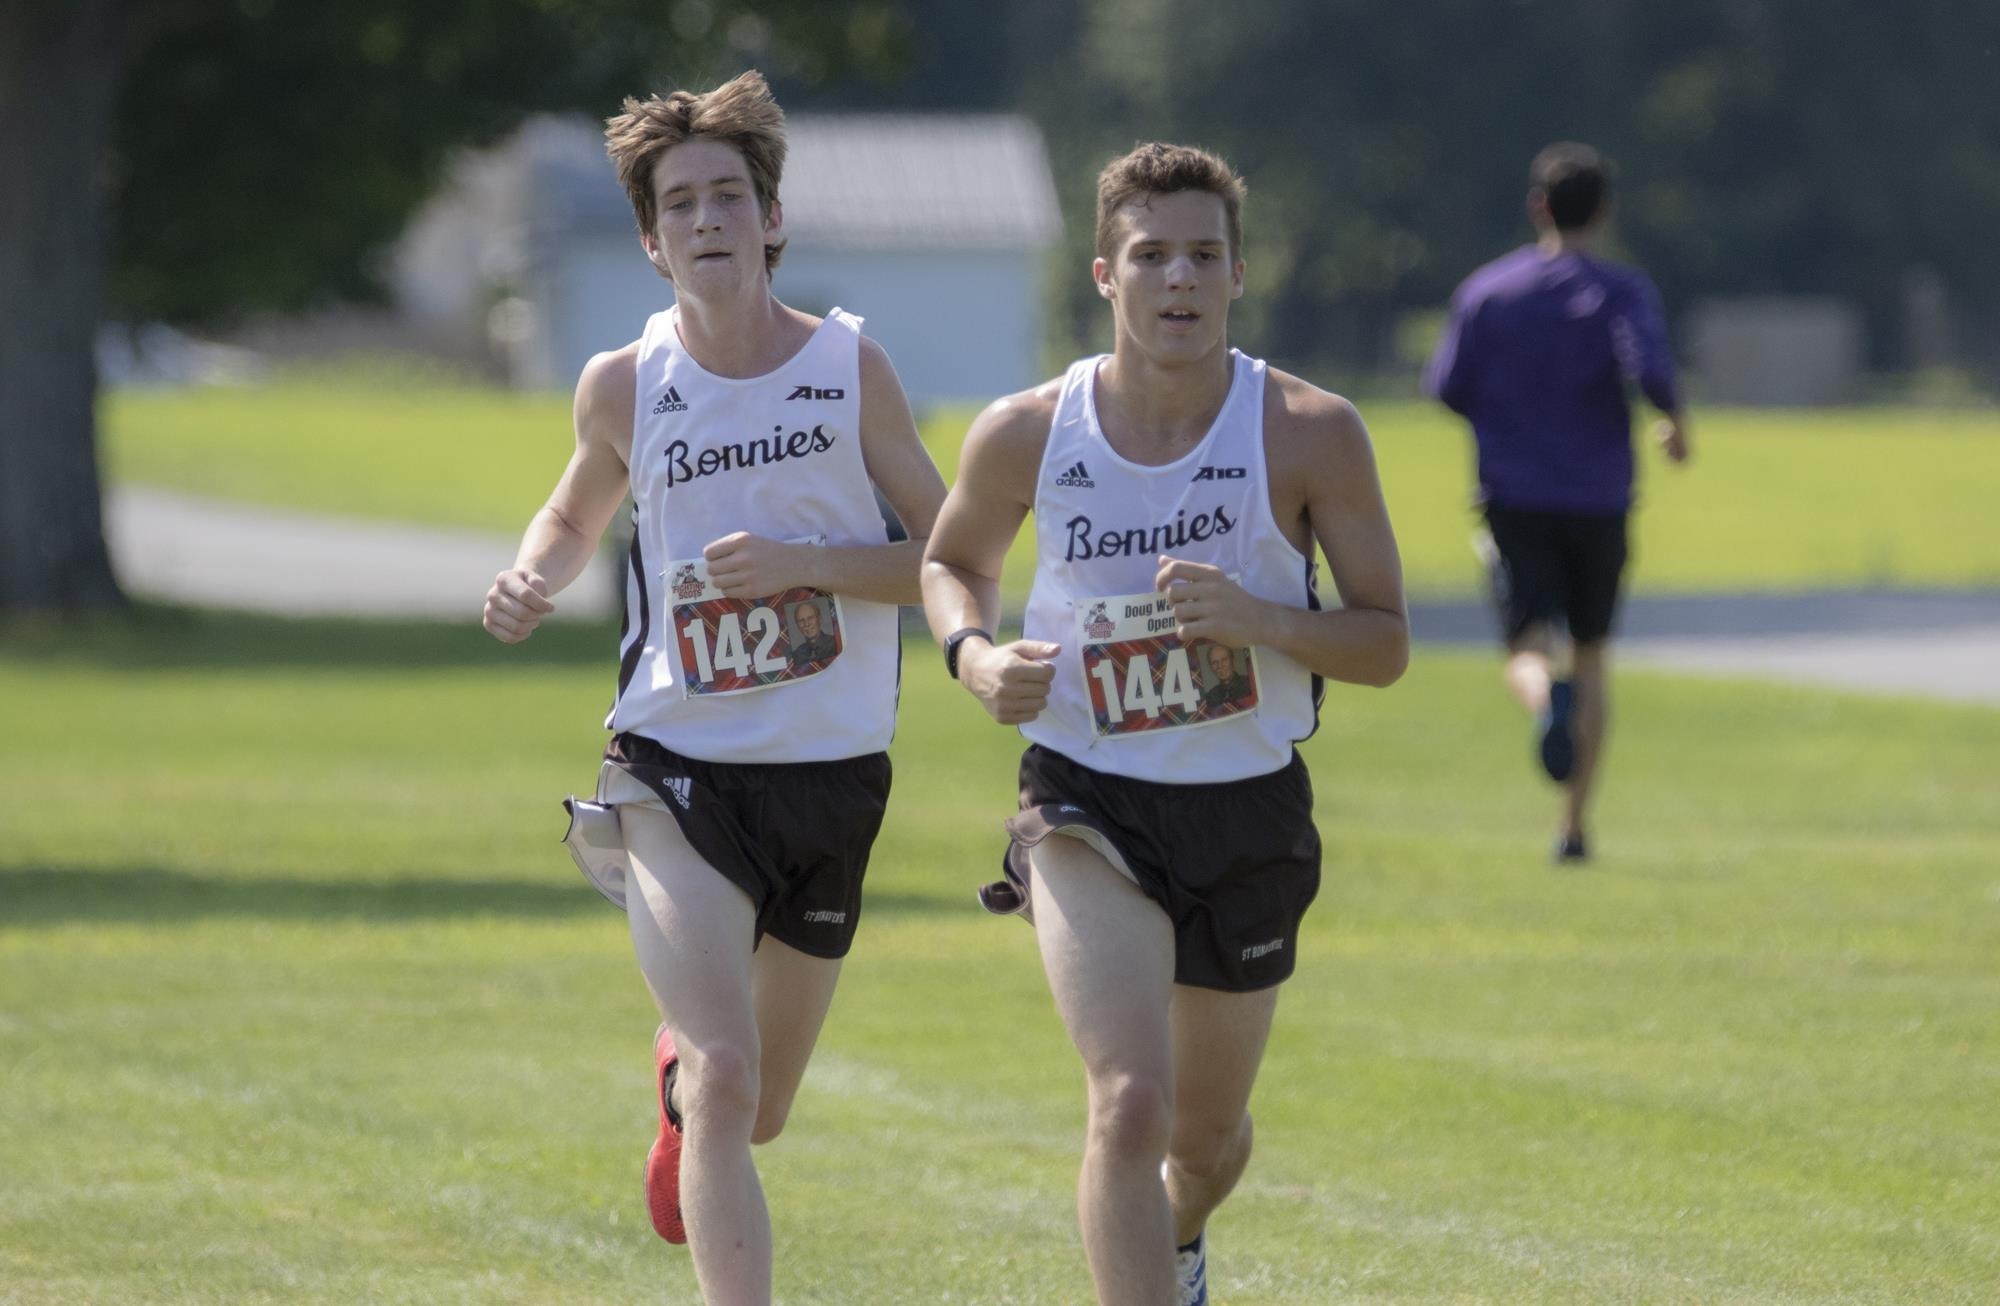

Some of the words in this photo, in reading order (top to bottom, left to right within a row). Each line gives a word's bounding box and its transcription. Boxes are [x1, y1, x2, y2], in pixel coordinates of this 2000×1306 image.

[784, 385, 845, 400] A10
[652, 402, 688, 415] adidas
[664, 424, 836, 489] Bonnies
[1191, 466, 1247, 482] A10
[1055, 476, 1096, 489] adidas
[1065, 504, 1237, 563] Bonnies
[679, 589, 703, 600] SCOTS
[1124, 603, 1153, 619] Doug
[1147, 616, 1176, 632] Open
[683, 607, 788, 683] 142
[1091, 647, 1201, 723] 144
